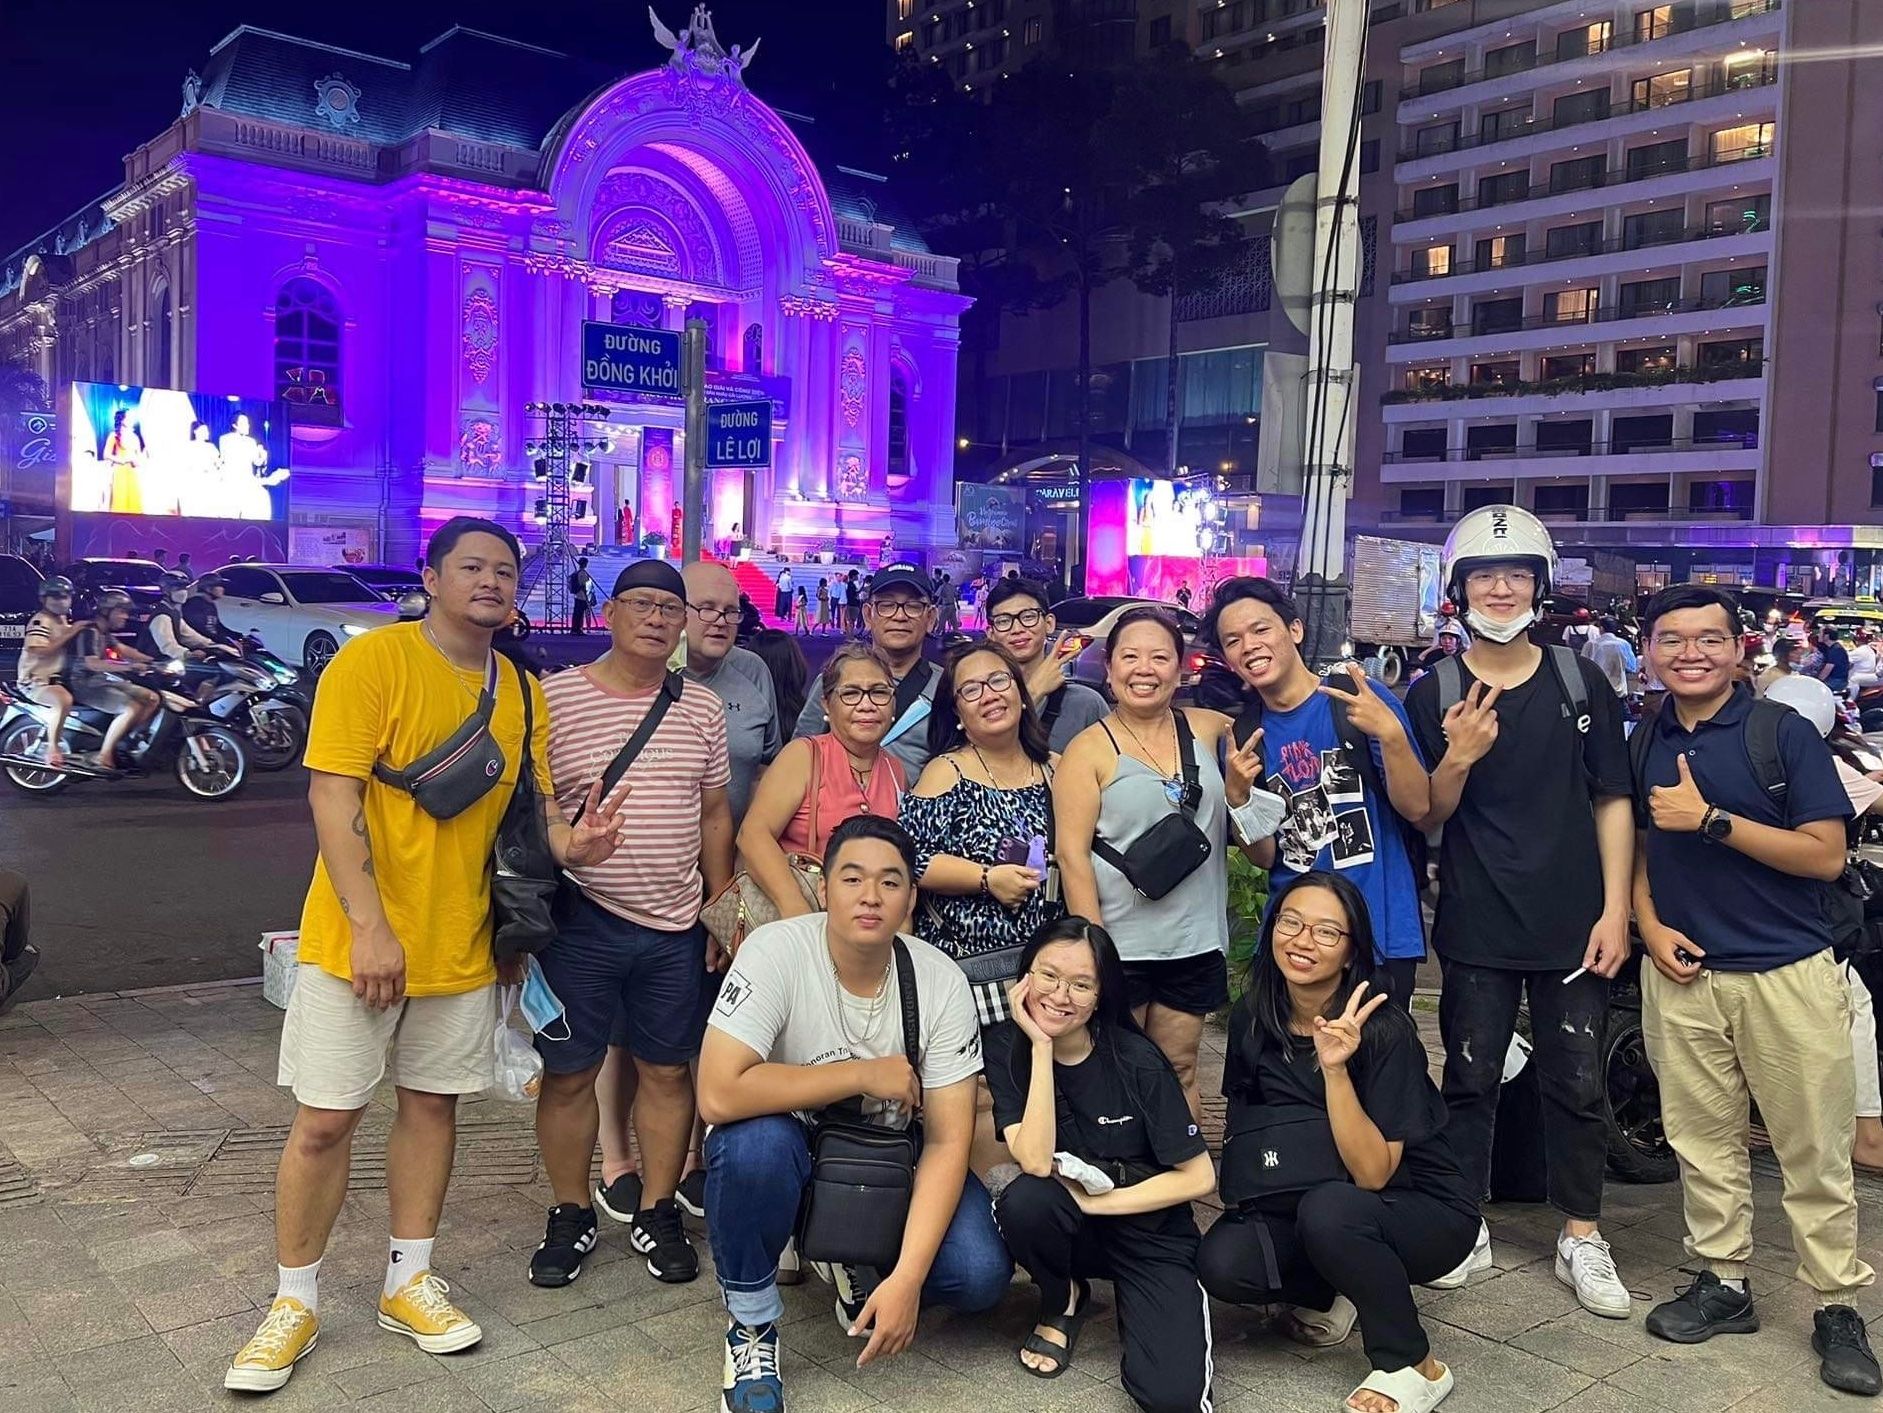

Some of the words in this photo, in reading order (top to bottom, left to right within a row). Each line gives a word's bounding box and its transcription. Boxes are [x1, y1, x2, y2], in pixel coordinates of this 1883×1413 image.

[604, 333, 661, 355] ĐƯỜNG
[587, 353, 635, 384] ĐỒNG
[640, 361, 678, 389] KHỞI
[721, 409, 758, 429] ĐƯỜNG
[717, 435, 735, 460] LÊ
[738, 437, 761, 463] LỢI
[1036, 487, 1080, 499] ARAVEL
[720, 982, 742, 1005] PA
